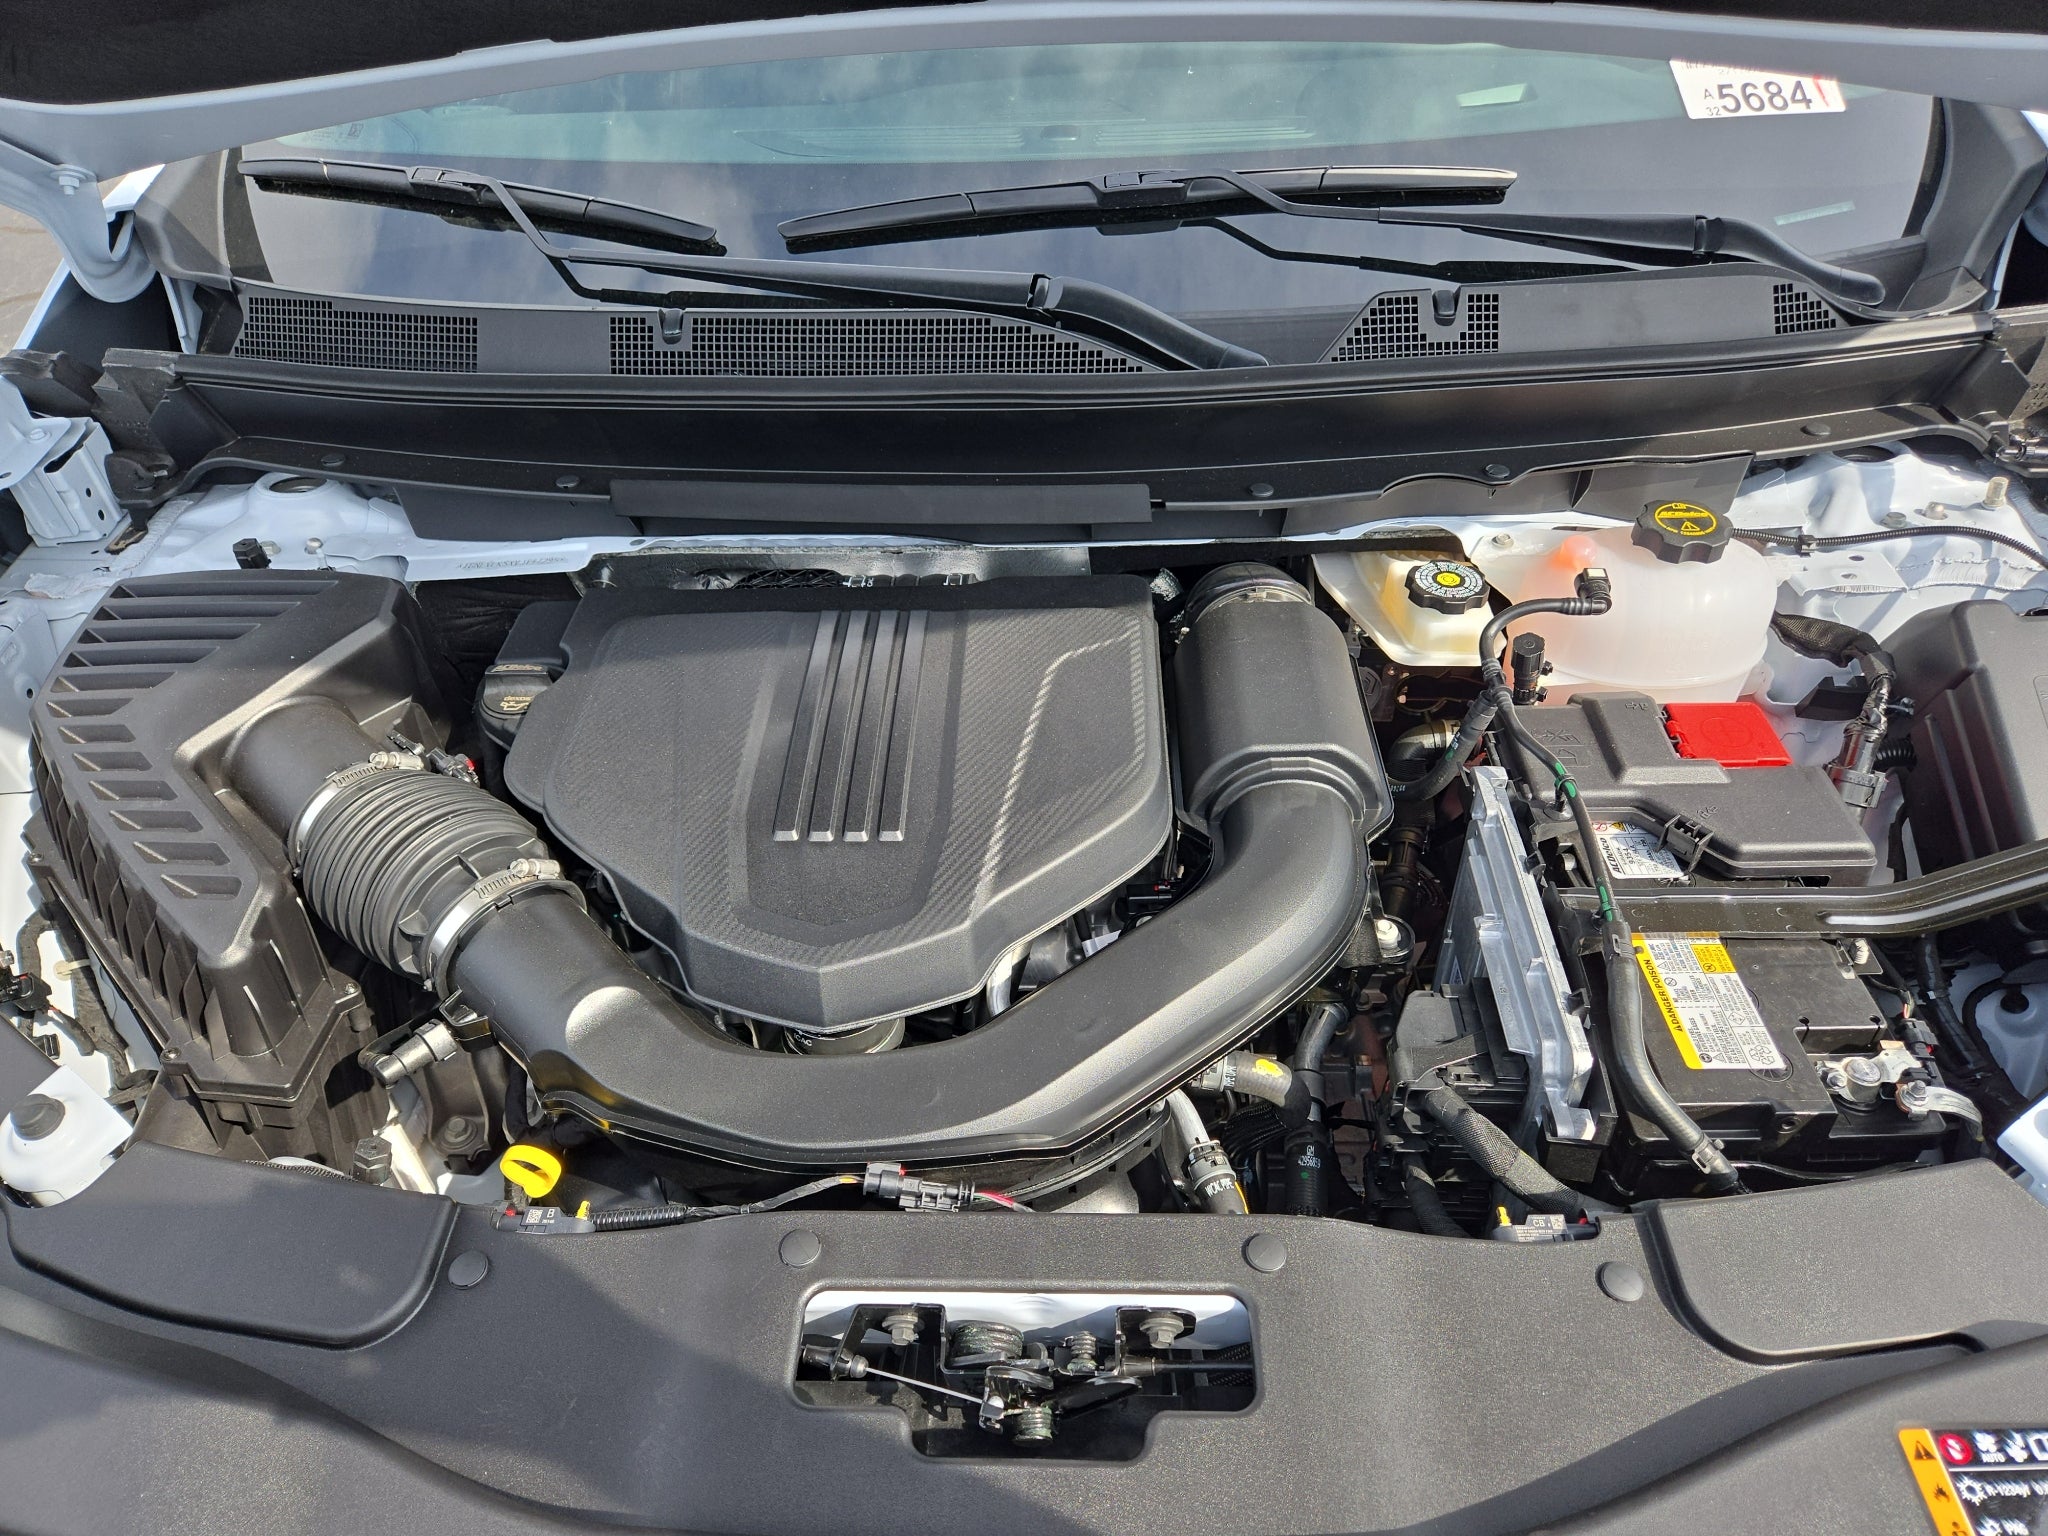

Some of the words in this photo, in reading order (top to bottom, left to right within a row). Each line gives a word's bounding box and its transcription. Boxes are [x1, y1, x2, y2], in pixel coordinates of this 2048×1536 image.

[1703, 88, 1714, 100] A
[1717, 80, 1812, 113] 5684
[1707, 107, 1721, 116] 32
[1600, 837, 1622, 873] ACDelco
[547, 1208, 555, 1218] B
[1533, 1219, 1545, 1227] CB
[1981, 1452, 2006, 1463] AUTO
